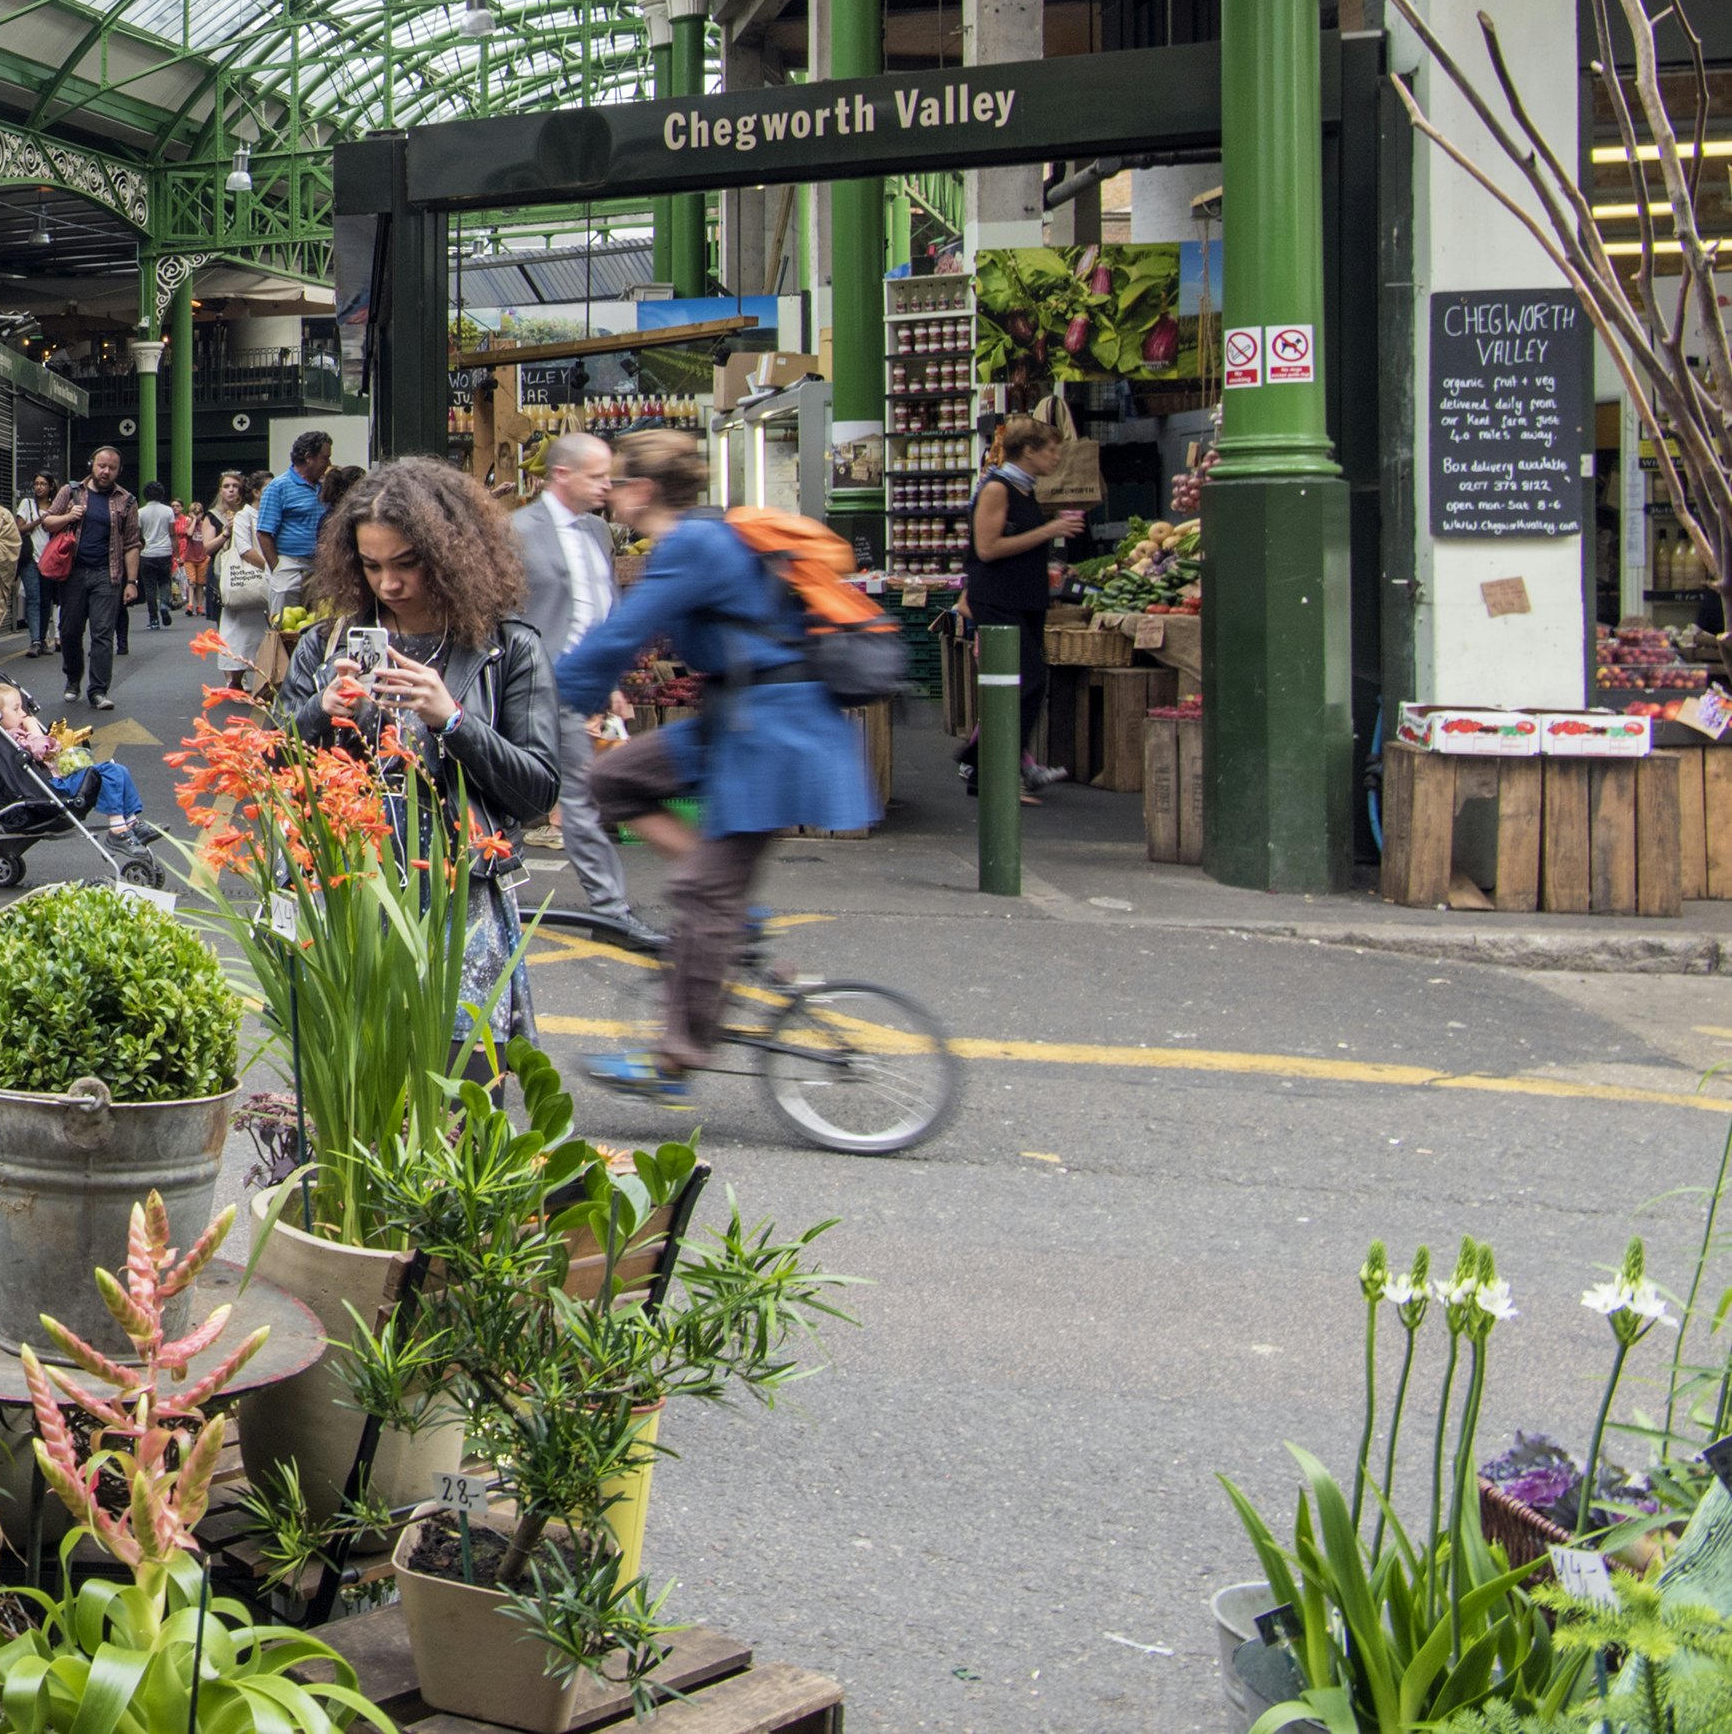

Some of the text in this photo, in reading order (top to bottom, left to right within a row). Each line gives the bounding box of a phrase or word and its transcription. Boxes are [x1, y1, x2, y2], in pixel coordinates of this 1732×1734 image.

[663, 83, 1016, 152] Chegworth Valley
[1444, 303, 1575, 337] CHEGWORTH
[1476, 338, 1549, 366] VALLEY
[1228, 376, 1252, 384] smoking
[1442, 377, 1485, 397] organic
[1493, 374, 1518, 392] fruit
[1535, 376, 1556, 393] veg
[1439, 395, 1558, 416] delivered daily from
[1440, 416, 1459, 426] our
[1501, 415, 1528, 430] farm
[1449, 429, 1558, 448] 40 miles away.
[1442, 456, 1468, 474] Box
[1470, 459, 1514, 480] delivery
[1458, 479, 1552, 492] 0207 378 8122
[1445, 500, 1475, 514] open
